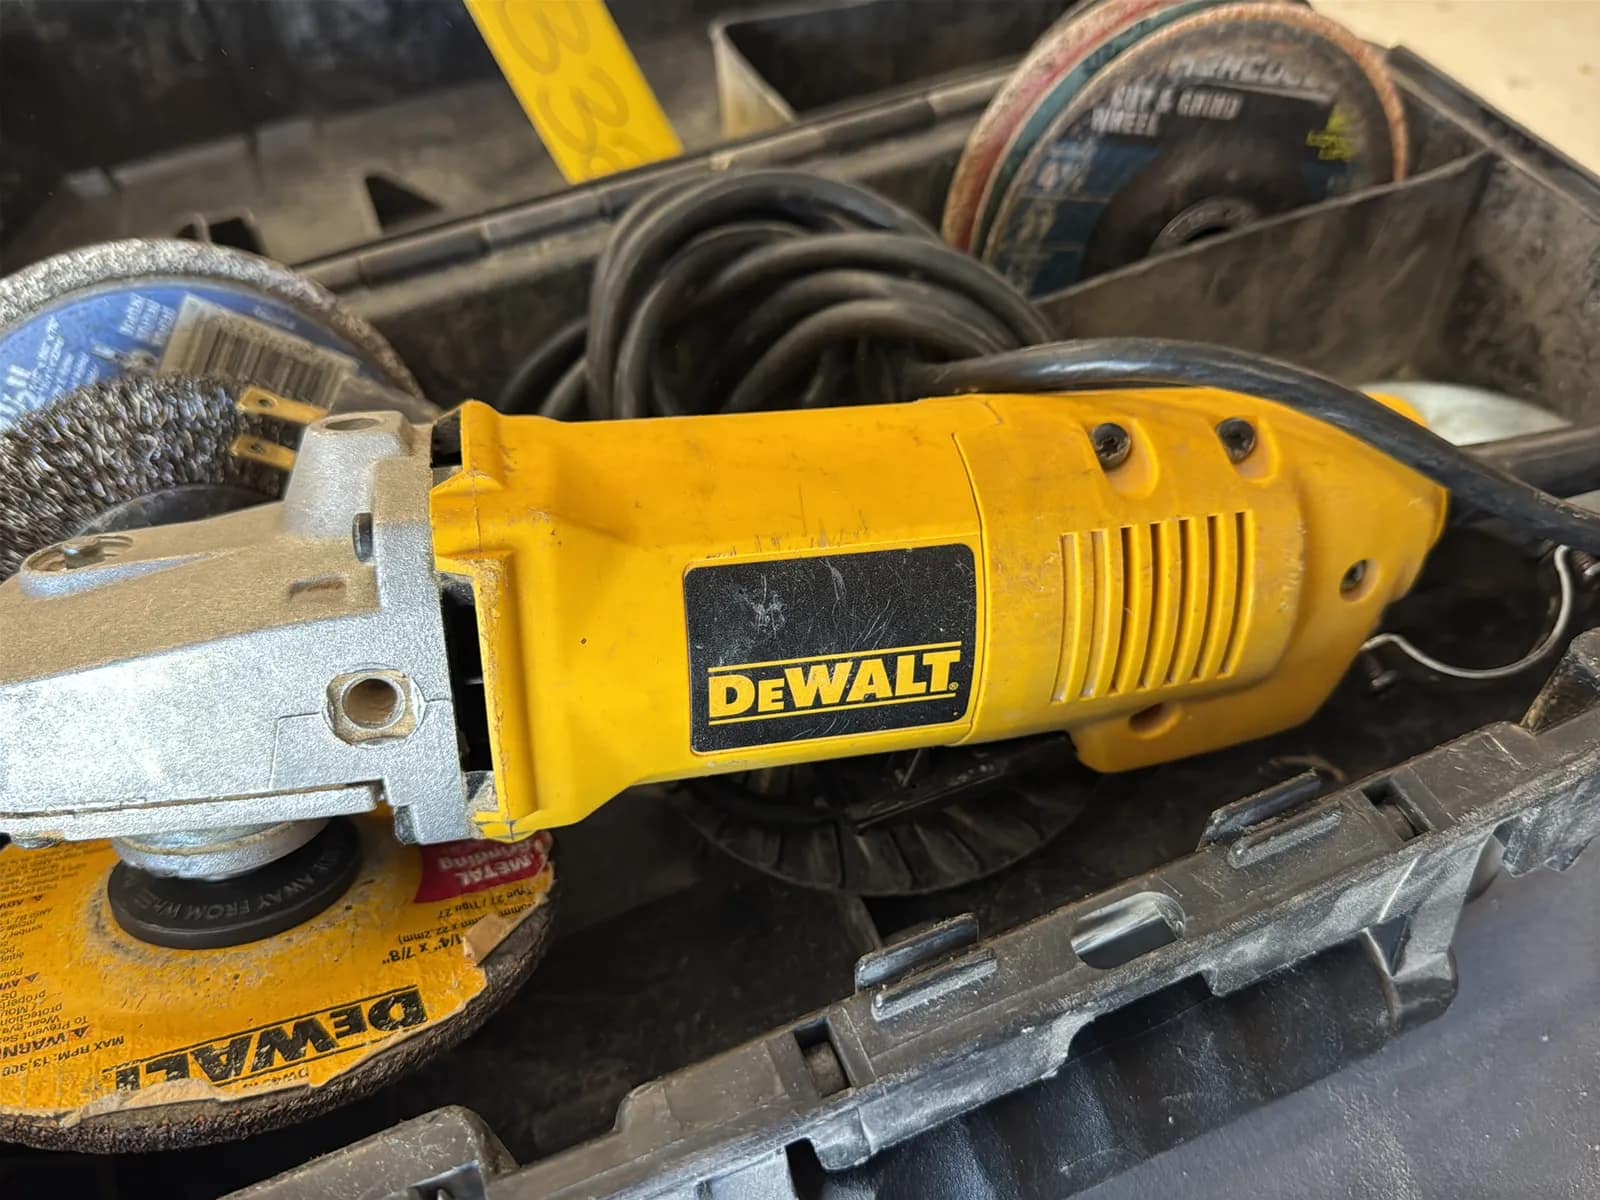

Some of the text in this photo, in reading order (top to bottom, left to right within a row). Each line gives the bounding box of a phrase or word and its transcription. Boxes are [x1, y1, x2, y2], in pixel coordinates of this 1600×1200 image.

[456, 854, 533, 886] METAL
[182, 897, 251, 921] FROM
[438, 908, 454, 920] 27
[418, 942, 429, 954] x
[73, 1015, 89, 1026] To
[22, 1020, 71, 1041] Prevent
[94, 1035, 125, 1052] MAX
[54, 1044, 91, 1062] RPM:
